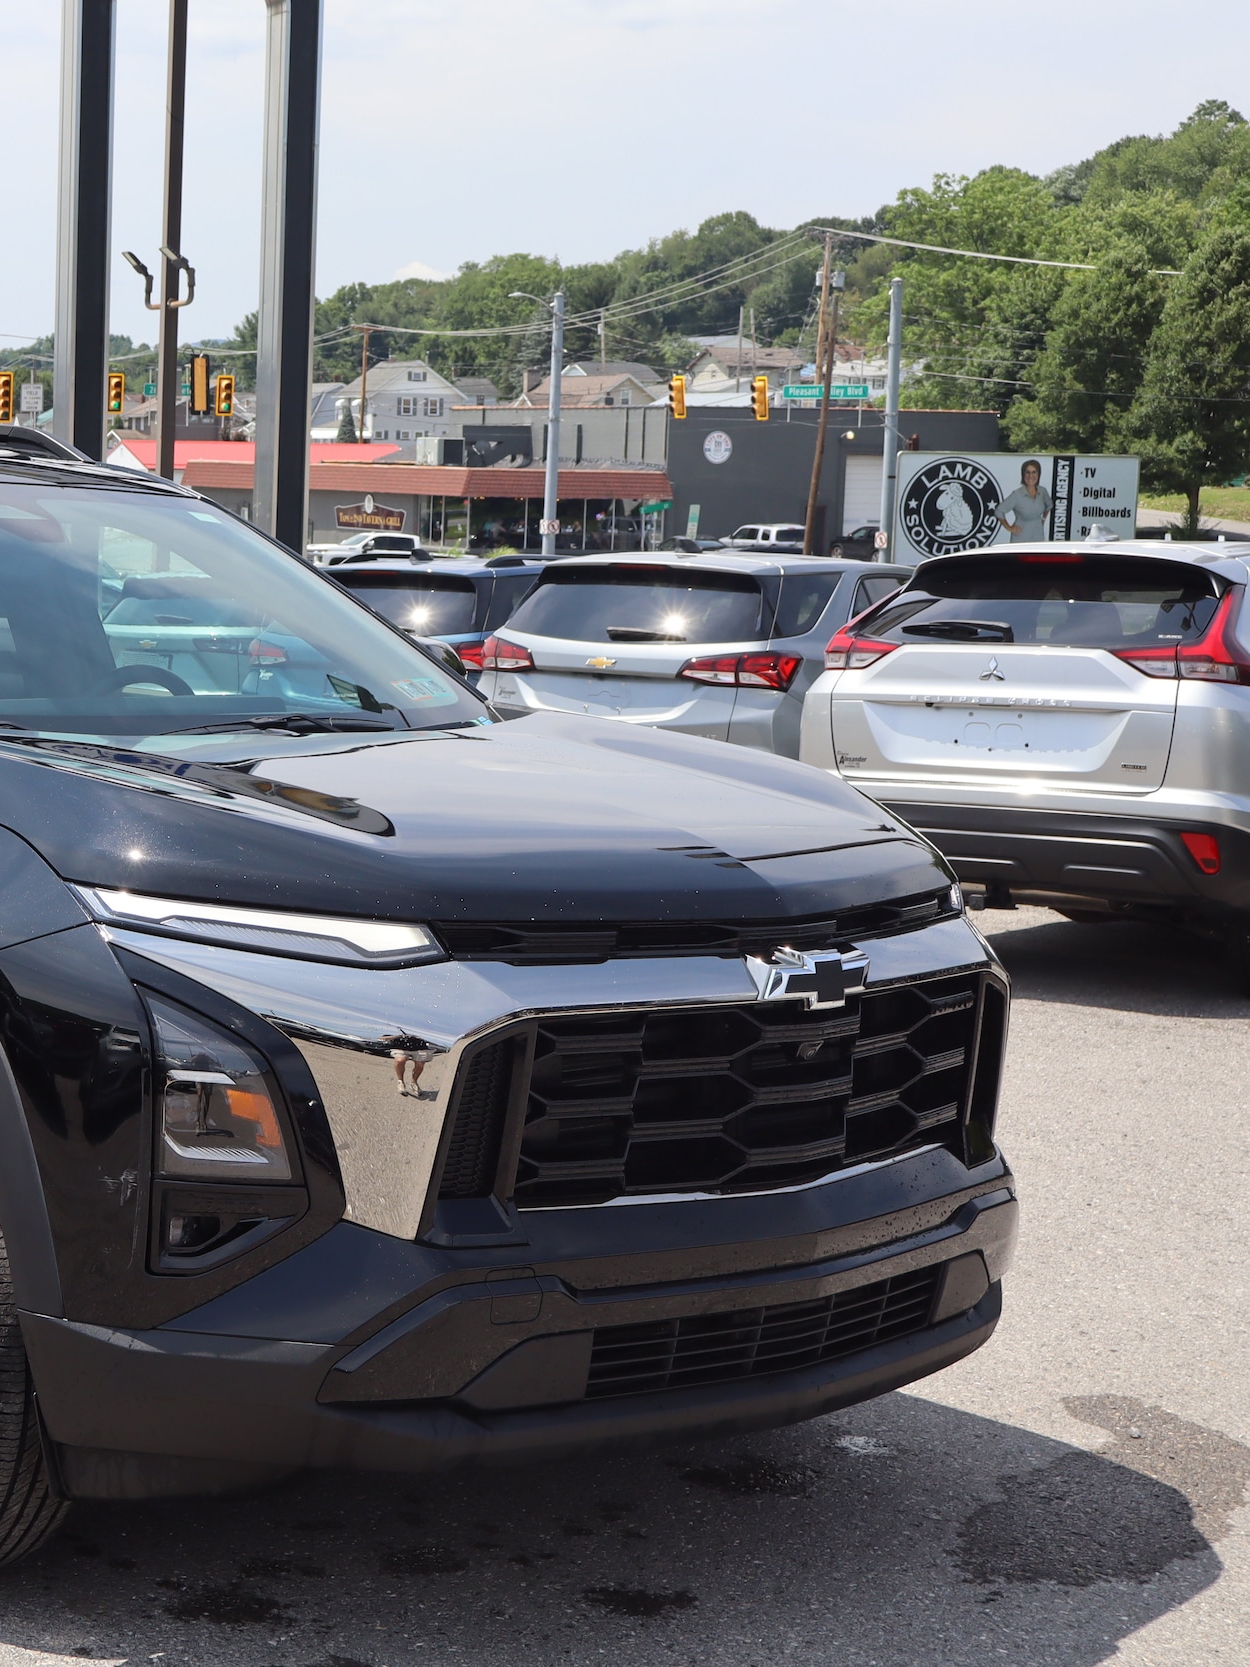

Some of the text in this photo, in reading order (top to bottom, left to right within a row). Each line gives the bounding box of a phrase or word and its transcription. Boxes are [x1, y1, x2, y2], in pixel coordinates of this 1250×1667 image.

[788, 387, 819, 396] Pleasant
[847, 387, 863, 396] Blvd
[920, 463, 988, 489] LAMB
[1085, 467, 1097, 478] TV
[1083, 487, 1116, 499] Digital
[1053, 459, 1070, 542] RTISING AGENCY
[1082, 506, 1131, 518] Billboards
[906, 513, 998, 556] SOLUTIONS
